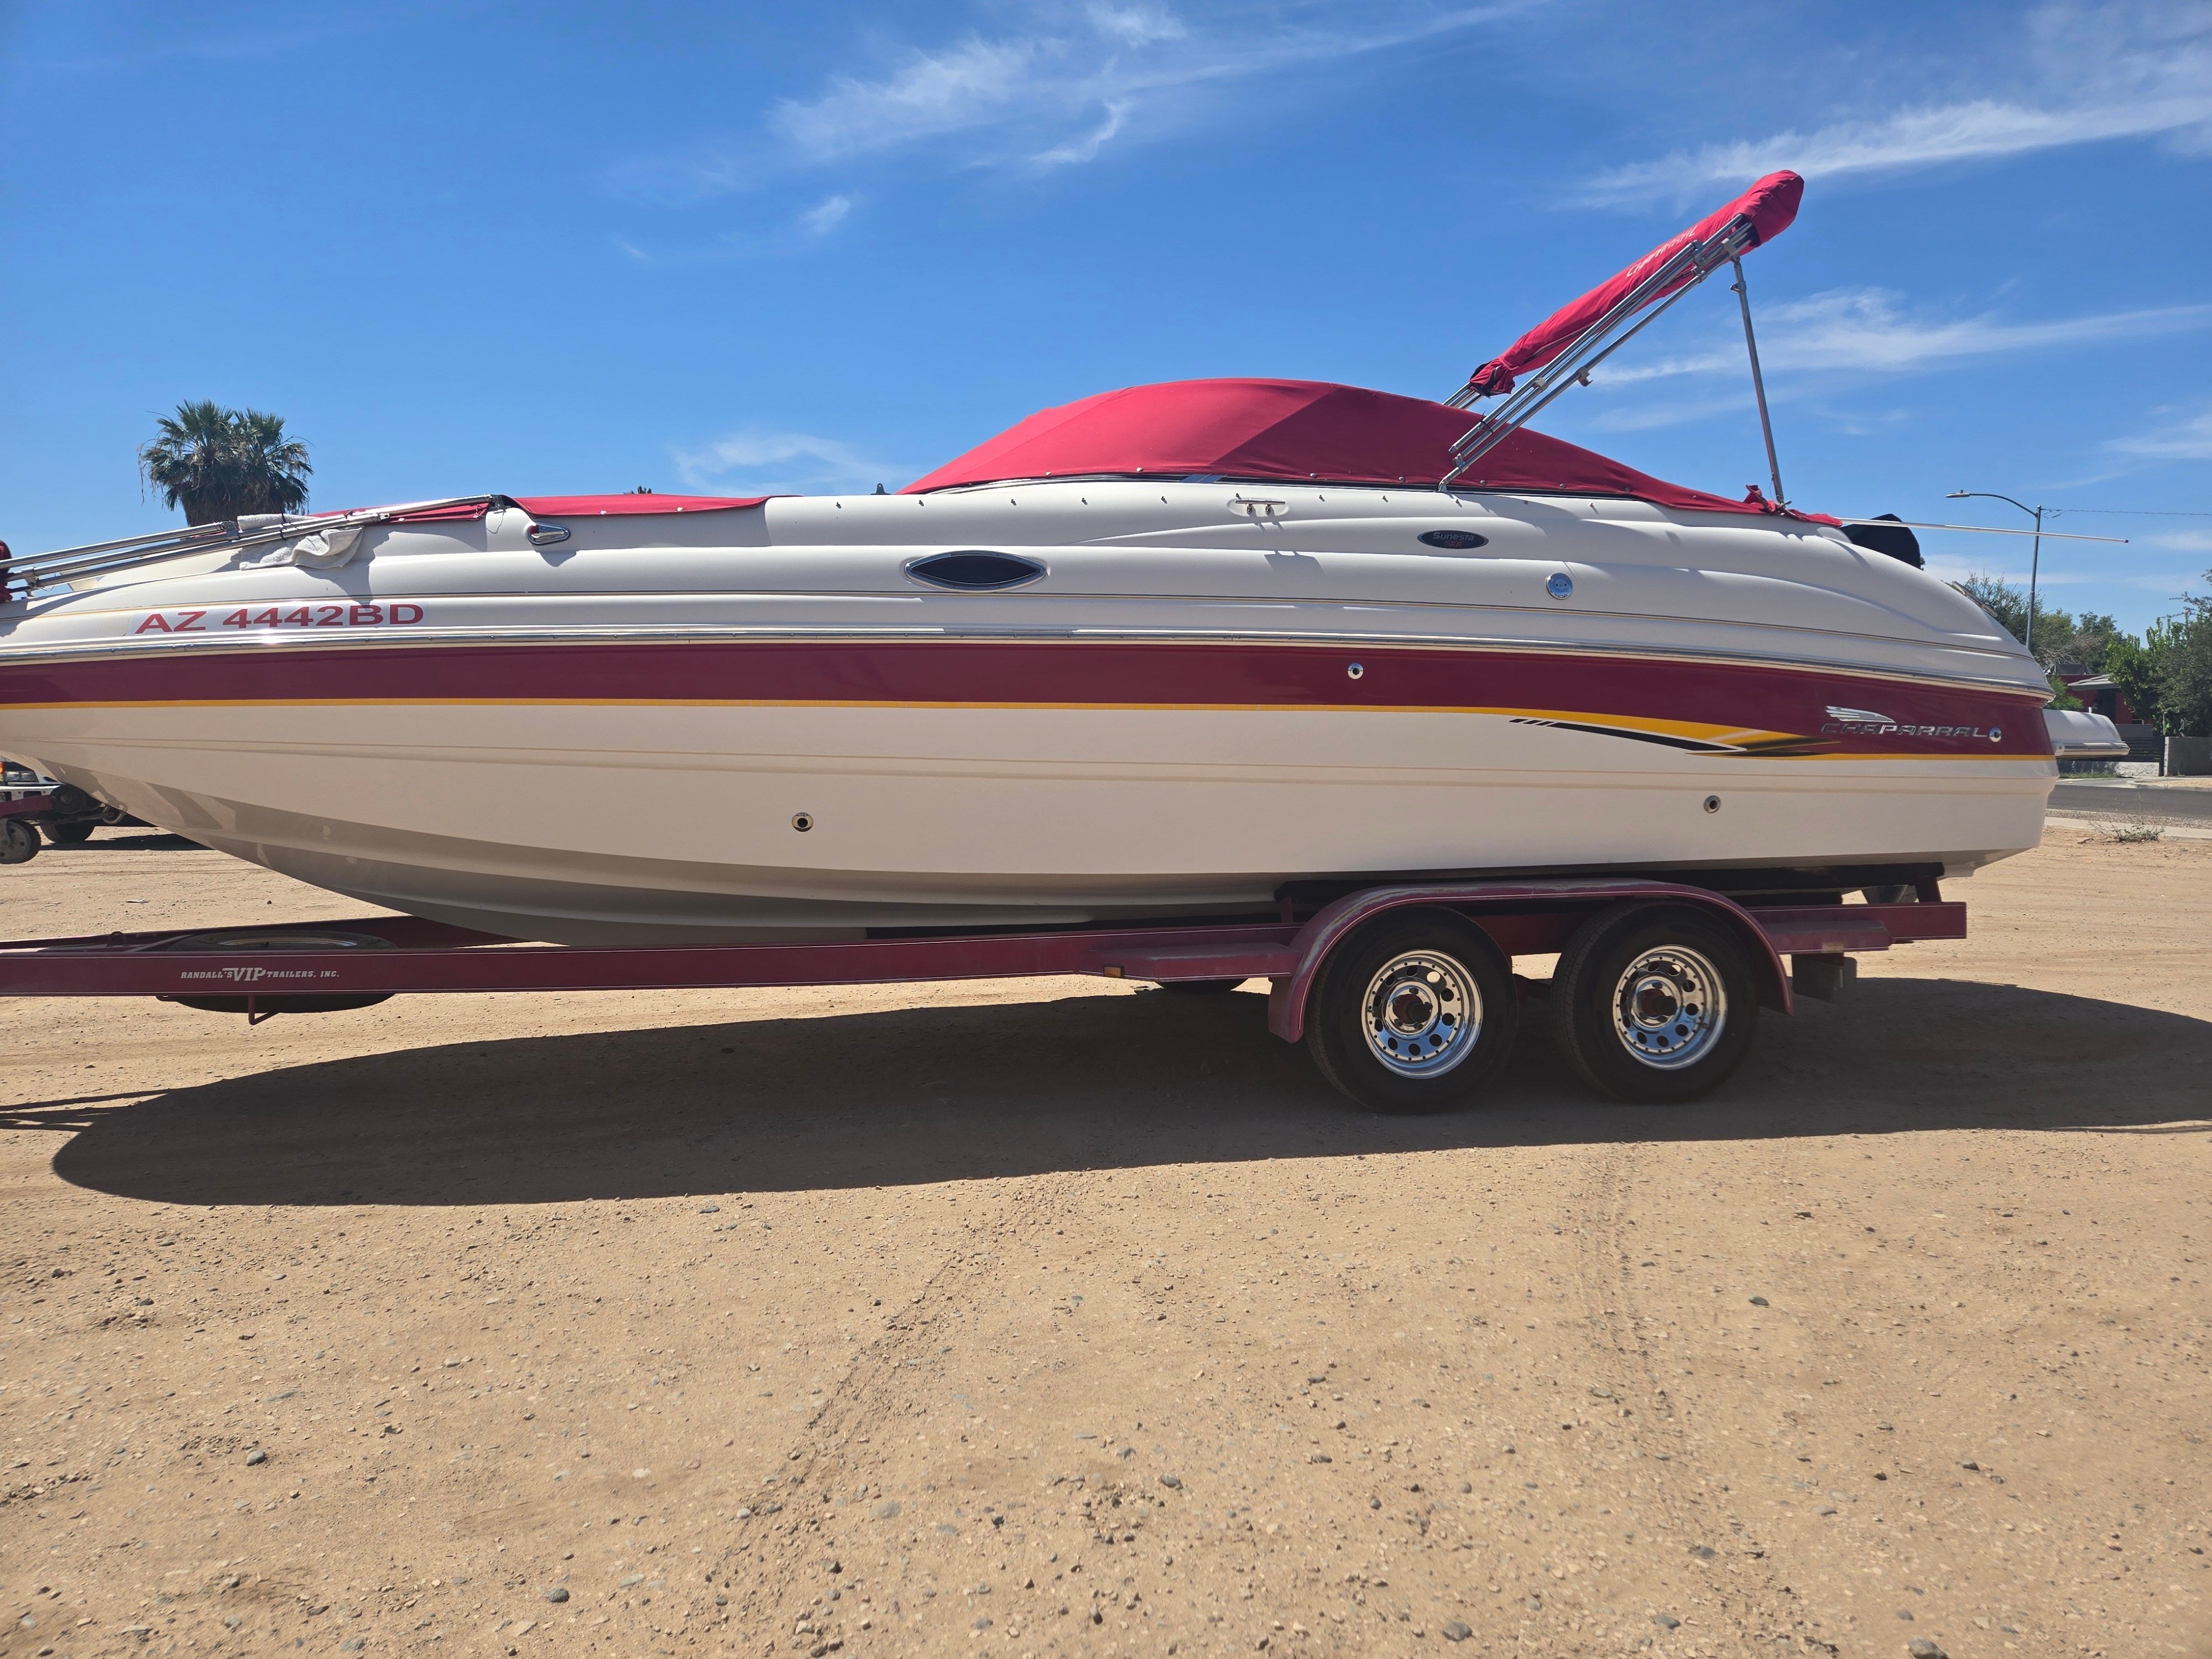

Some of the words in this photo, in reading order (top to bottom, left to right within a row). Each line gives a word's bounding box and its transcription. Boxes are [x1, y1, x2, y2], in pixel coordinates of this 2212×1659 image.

[1433, 532, 1474, 541] Sunesta
[134, 611, 207, 634] AZ
[222, 603, 424, 629] 4442BD
[1820, 723, 1987, 738] CHAPARRAL
[180, 971, 233, 979] RANDALL'S
[222, 967, 266, 982] VIP
